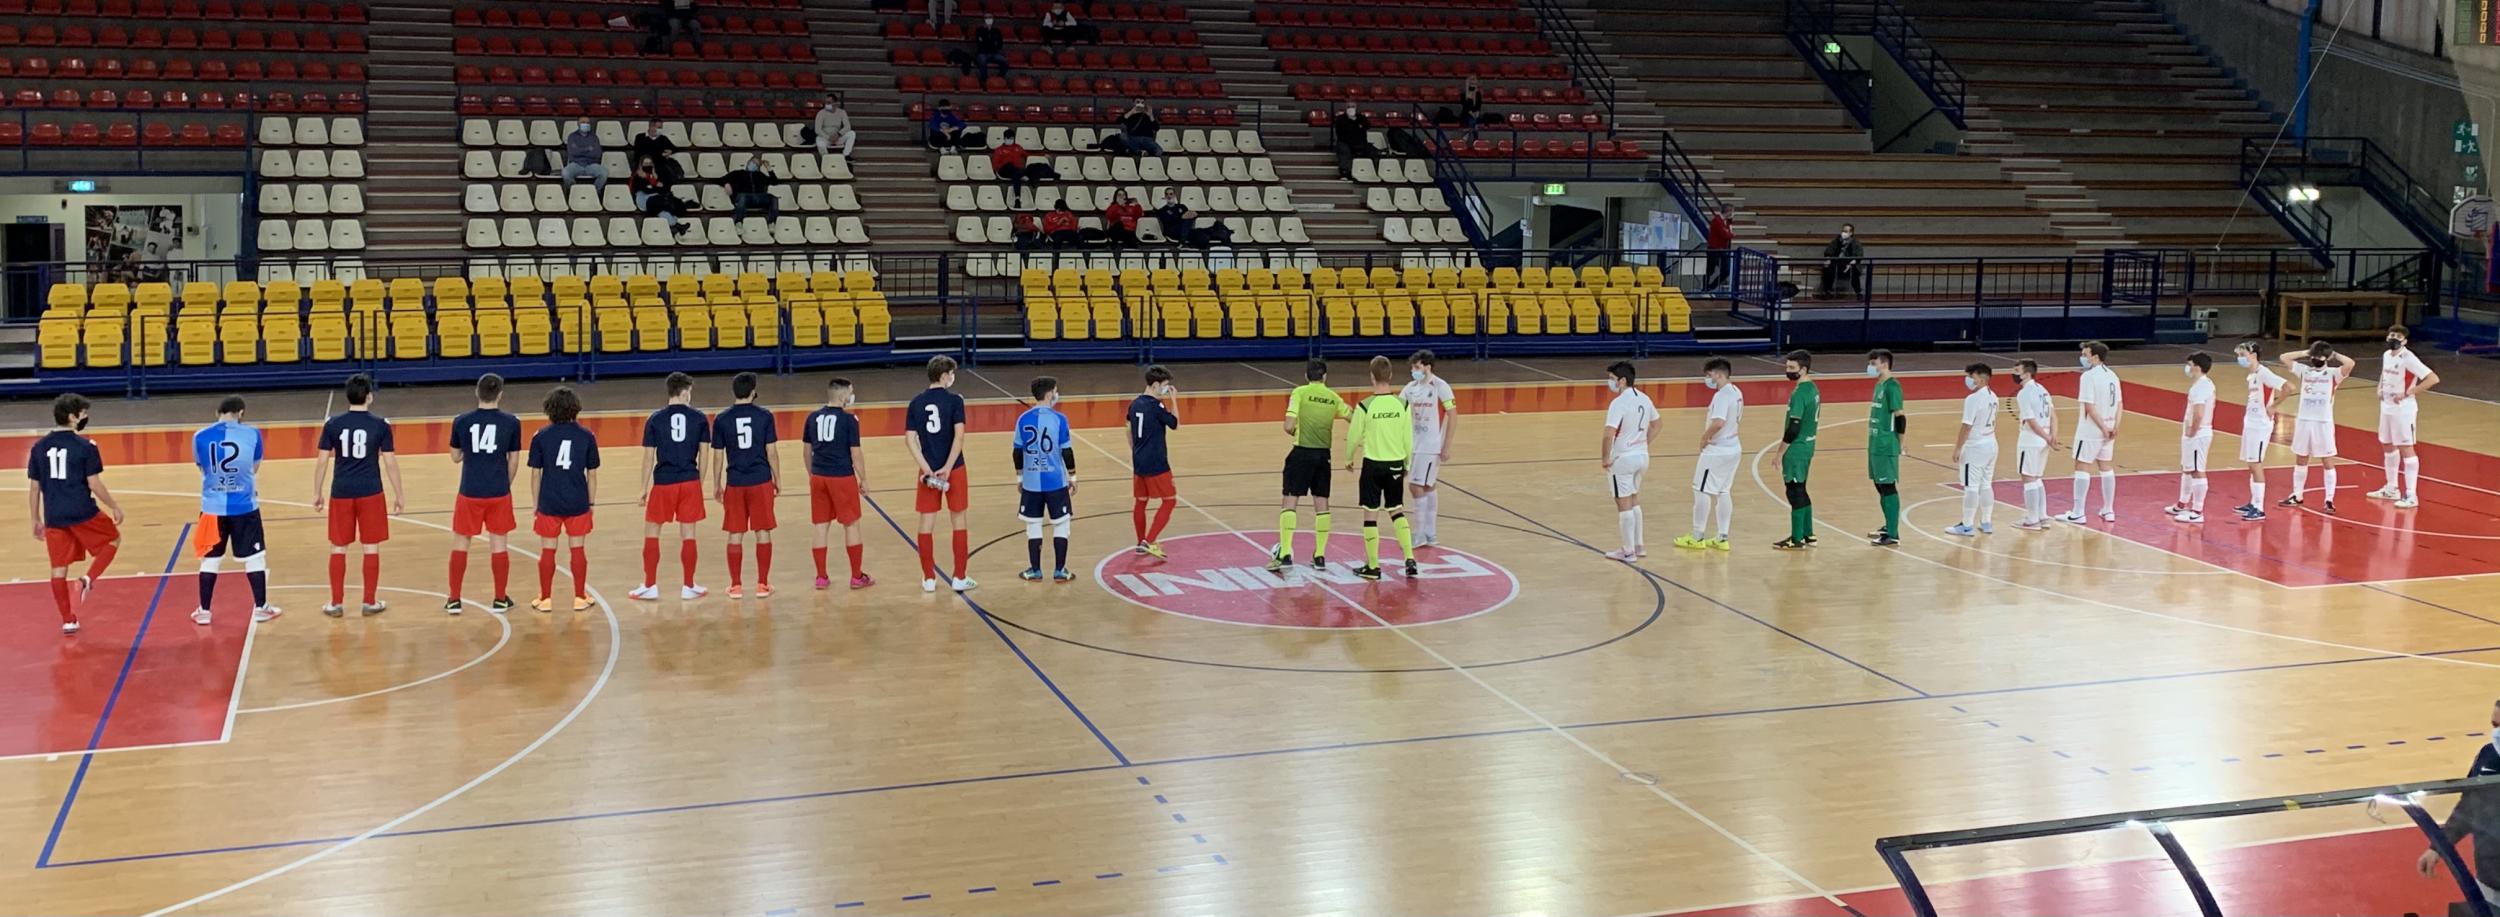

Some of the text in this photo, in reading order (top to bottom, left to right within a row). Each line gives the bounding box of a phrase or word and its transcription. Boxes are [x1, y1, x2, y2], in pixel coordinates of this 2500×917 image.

[1308, 395, 1336, 405] LEGEA
[670, 413, 687, 442] 9
[816, 414, 837, 442] 10
[924, 404, 942, 434] 3
[1372, 411, 1401, 420] LEGEA
[1638, 405, 1645, 432] 2
[339, 429, 368, 459] 18
[469, 423, 498, 454] 14
[735, 417, 752, 449] 5
[1023, 426, 1053, 454] 26
[46, 447, 67, 479] 11
[209, 441, 240, 474] 12
[555, 440, 572, 470] 4
